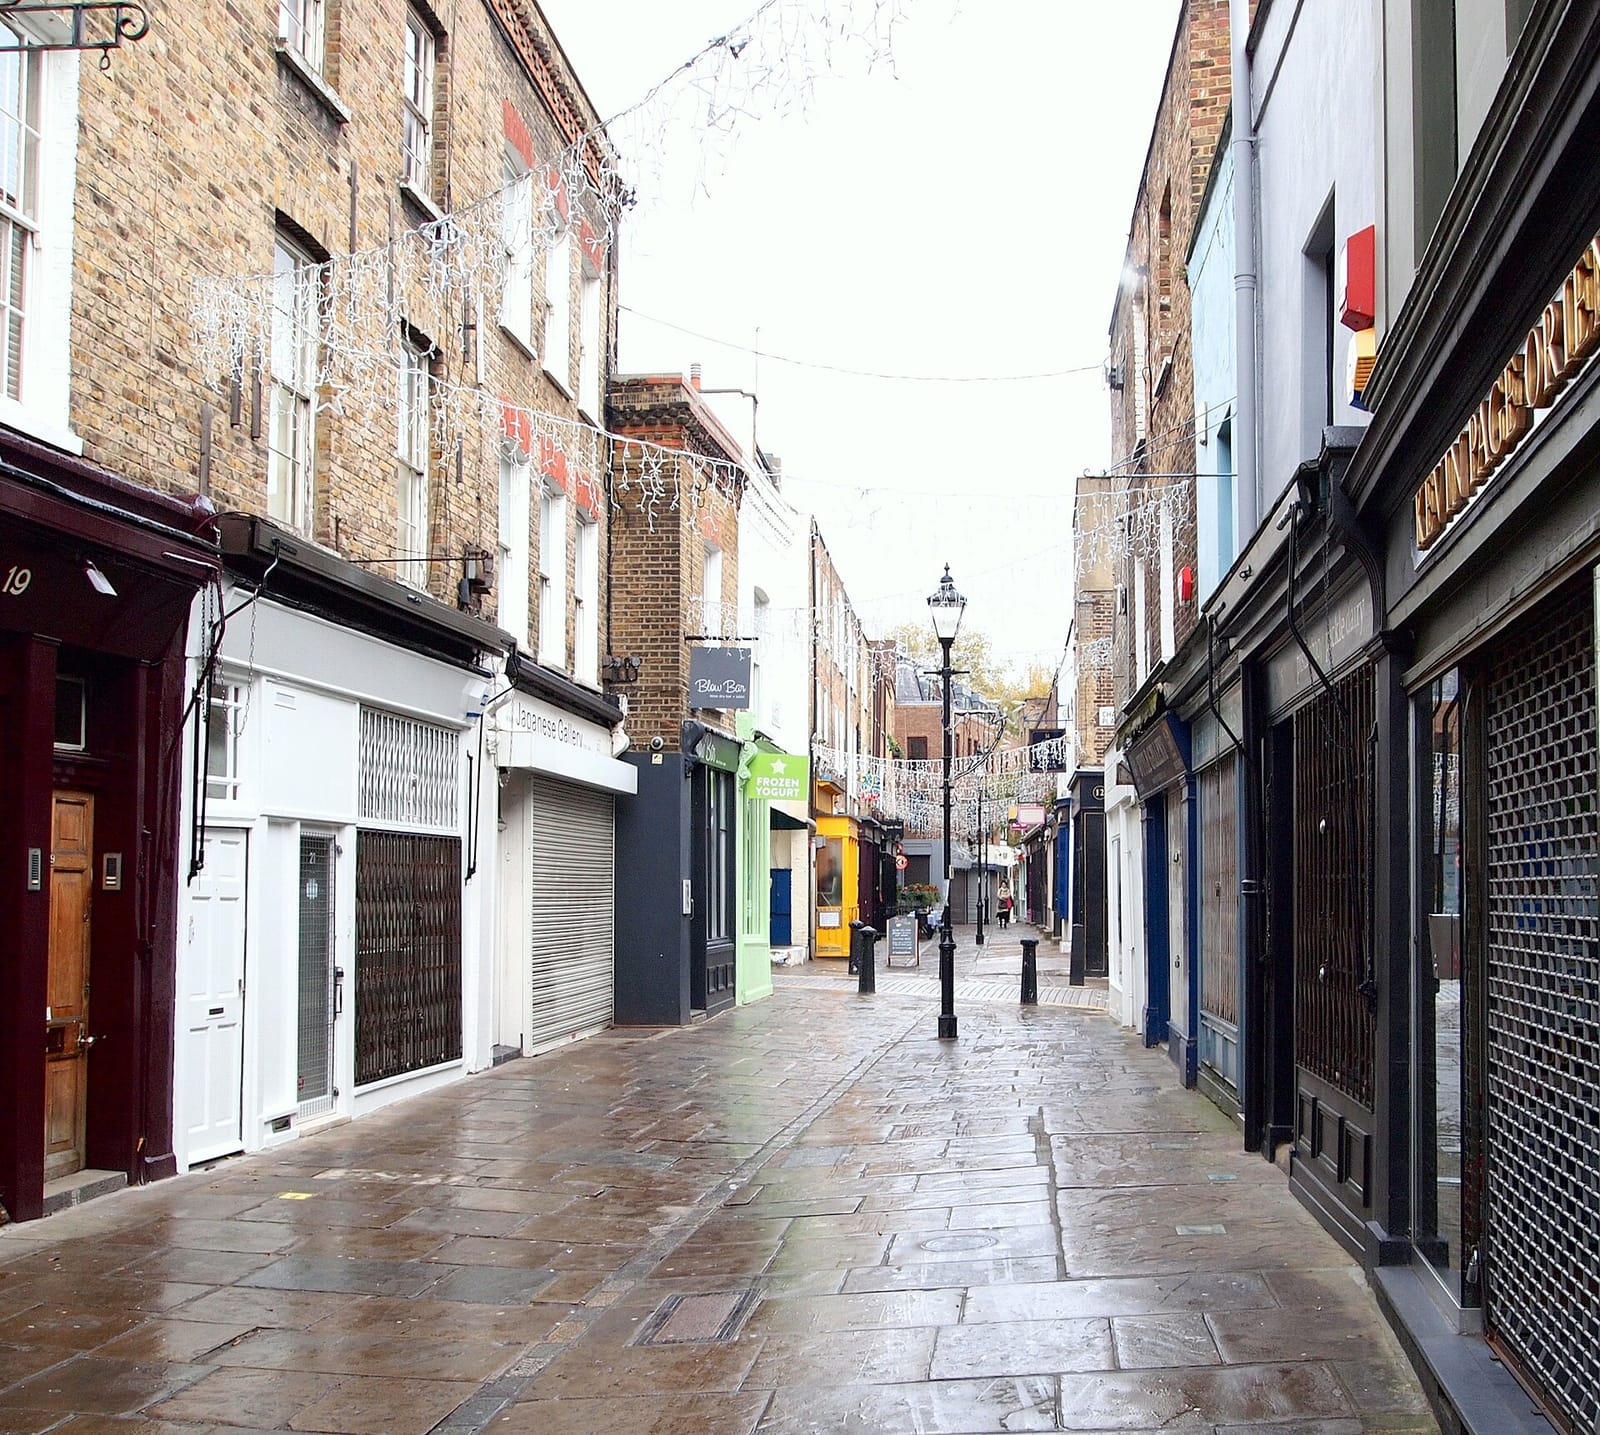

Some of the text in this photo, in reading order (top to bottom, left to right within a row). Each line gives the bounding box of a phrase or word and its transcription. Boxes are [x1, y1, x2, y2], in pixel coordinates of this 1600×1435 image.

[1415, 430, 1472, 551] KEVIN
[1468, 353, 1534, 487] PAGE
[2, 565, 32, 596] 19
[694, 678, 747, 694] Blow Bar
[515, 702, 584, 749] Japanese Gallery
[756, 776, 800, 788] FROZEN
[755, 786, 800, 797] YOGURT
[1095, 788, 1105, 797] 12
